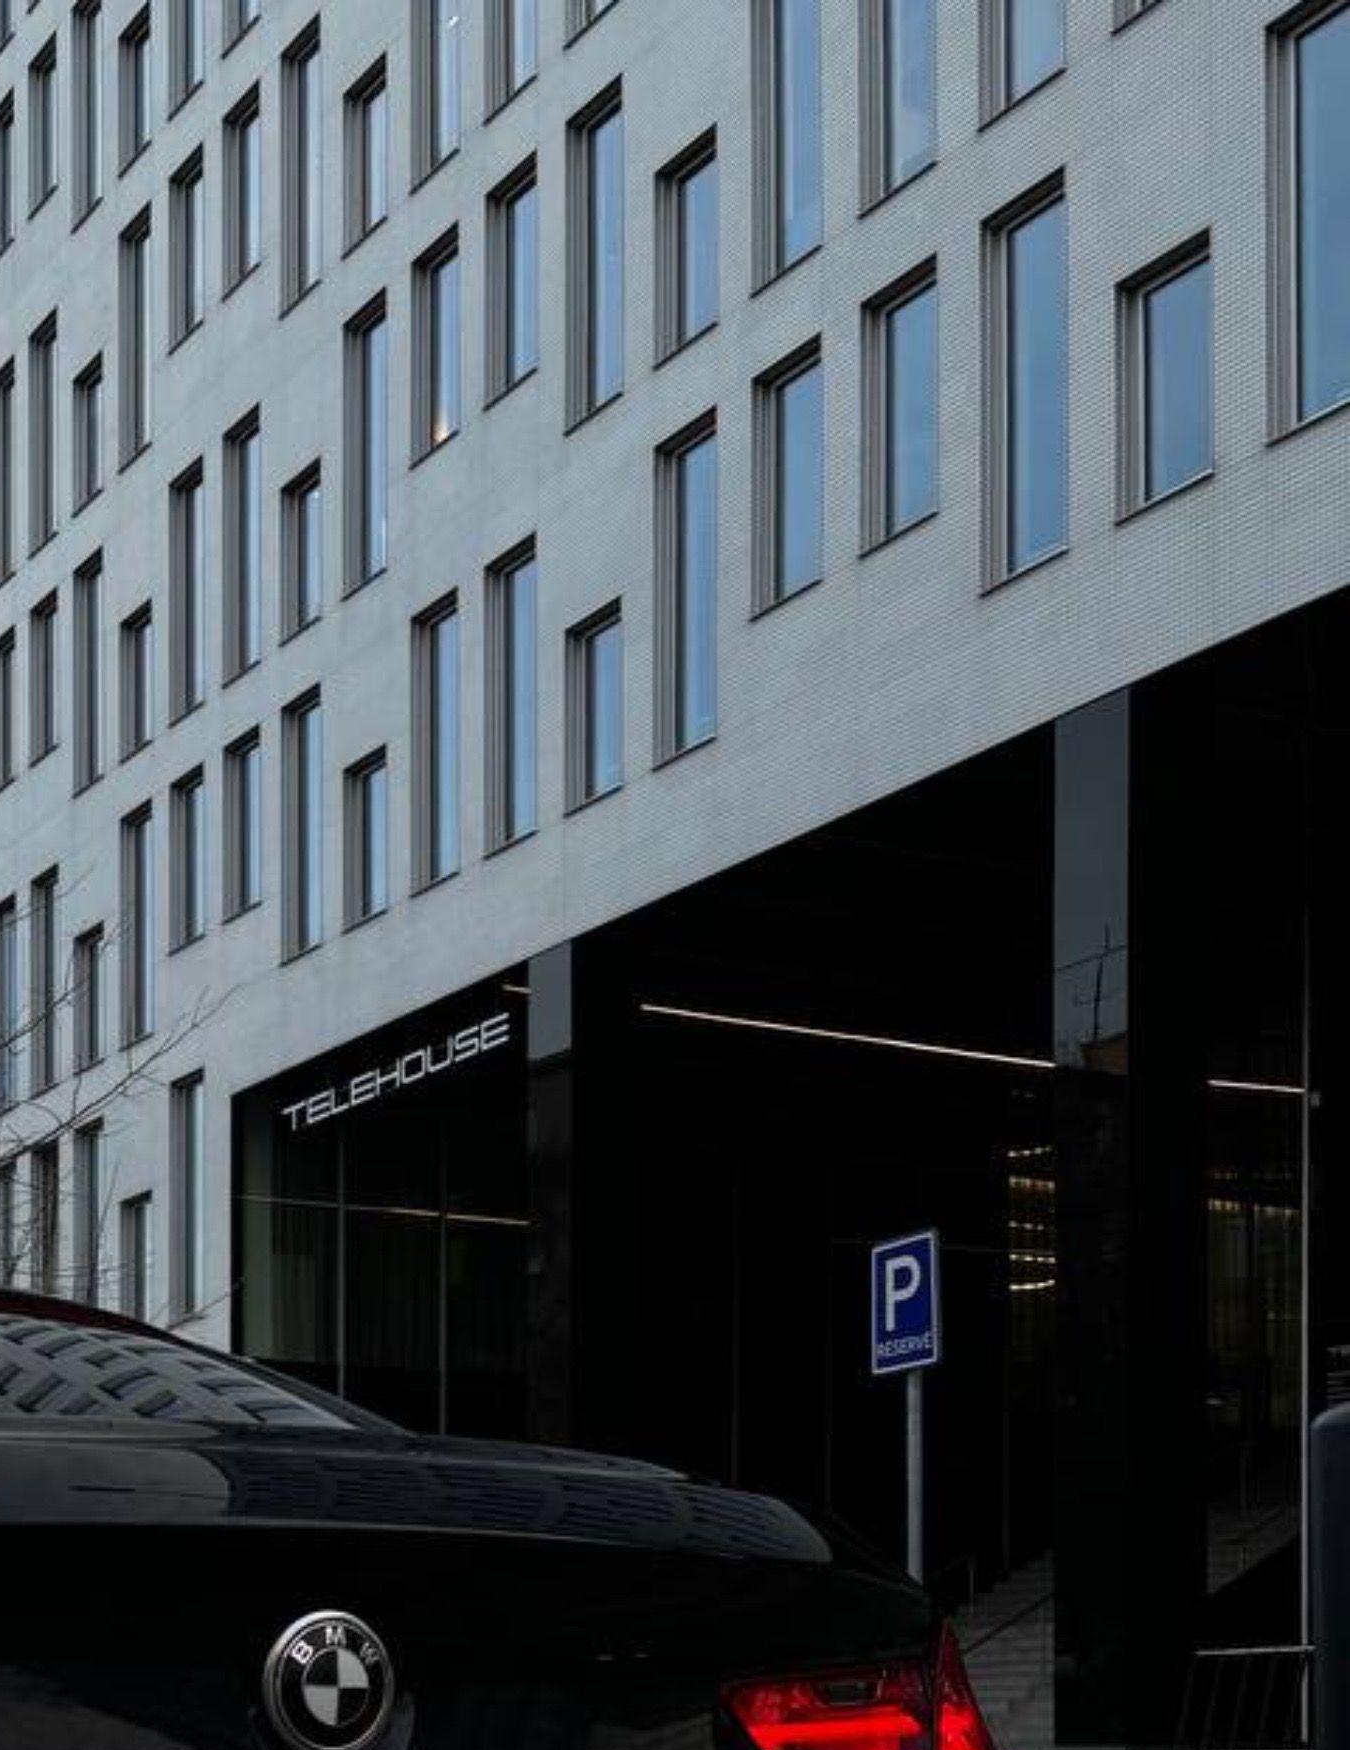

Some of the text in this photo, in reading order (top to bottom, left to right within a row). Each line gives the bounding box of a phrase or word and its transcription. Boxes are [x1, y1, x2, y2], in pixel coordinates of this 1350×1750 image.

[281, 1012, 509, 1131] TELEHOUSE
[885, 1255, 921, 1332] P
[291, 1625, 380, 1665] BMW
